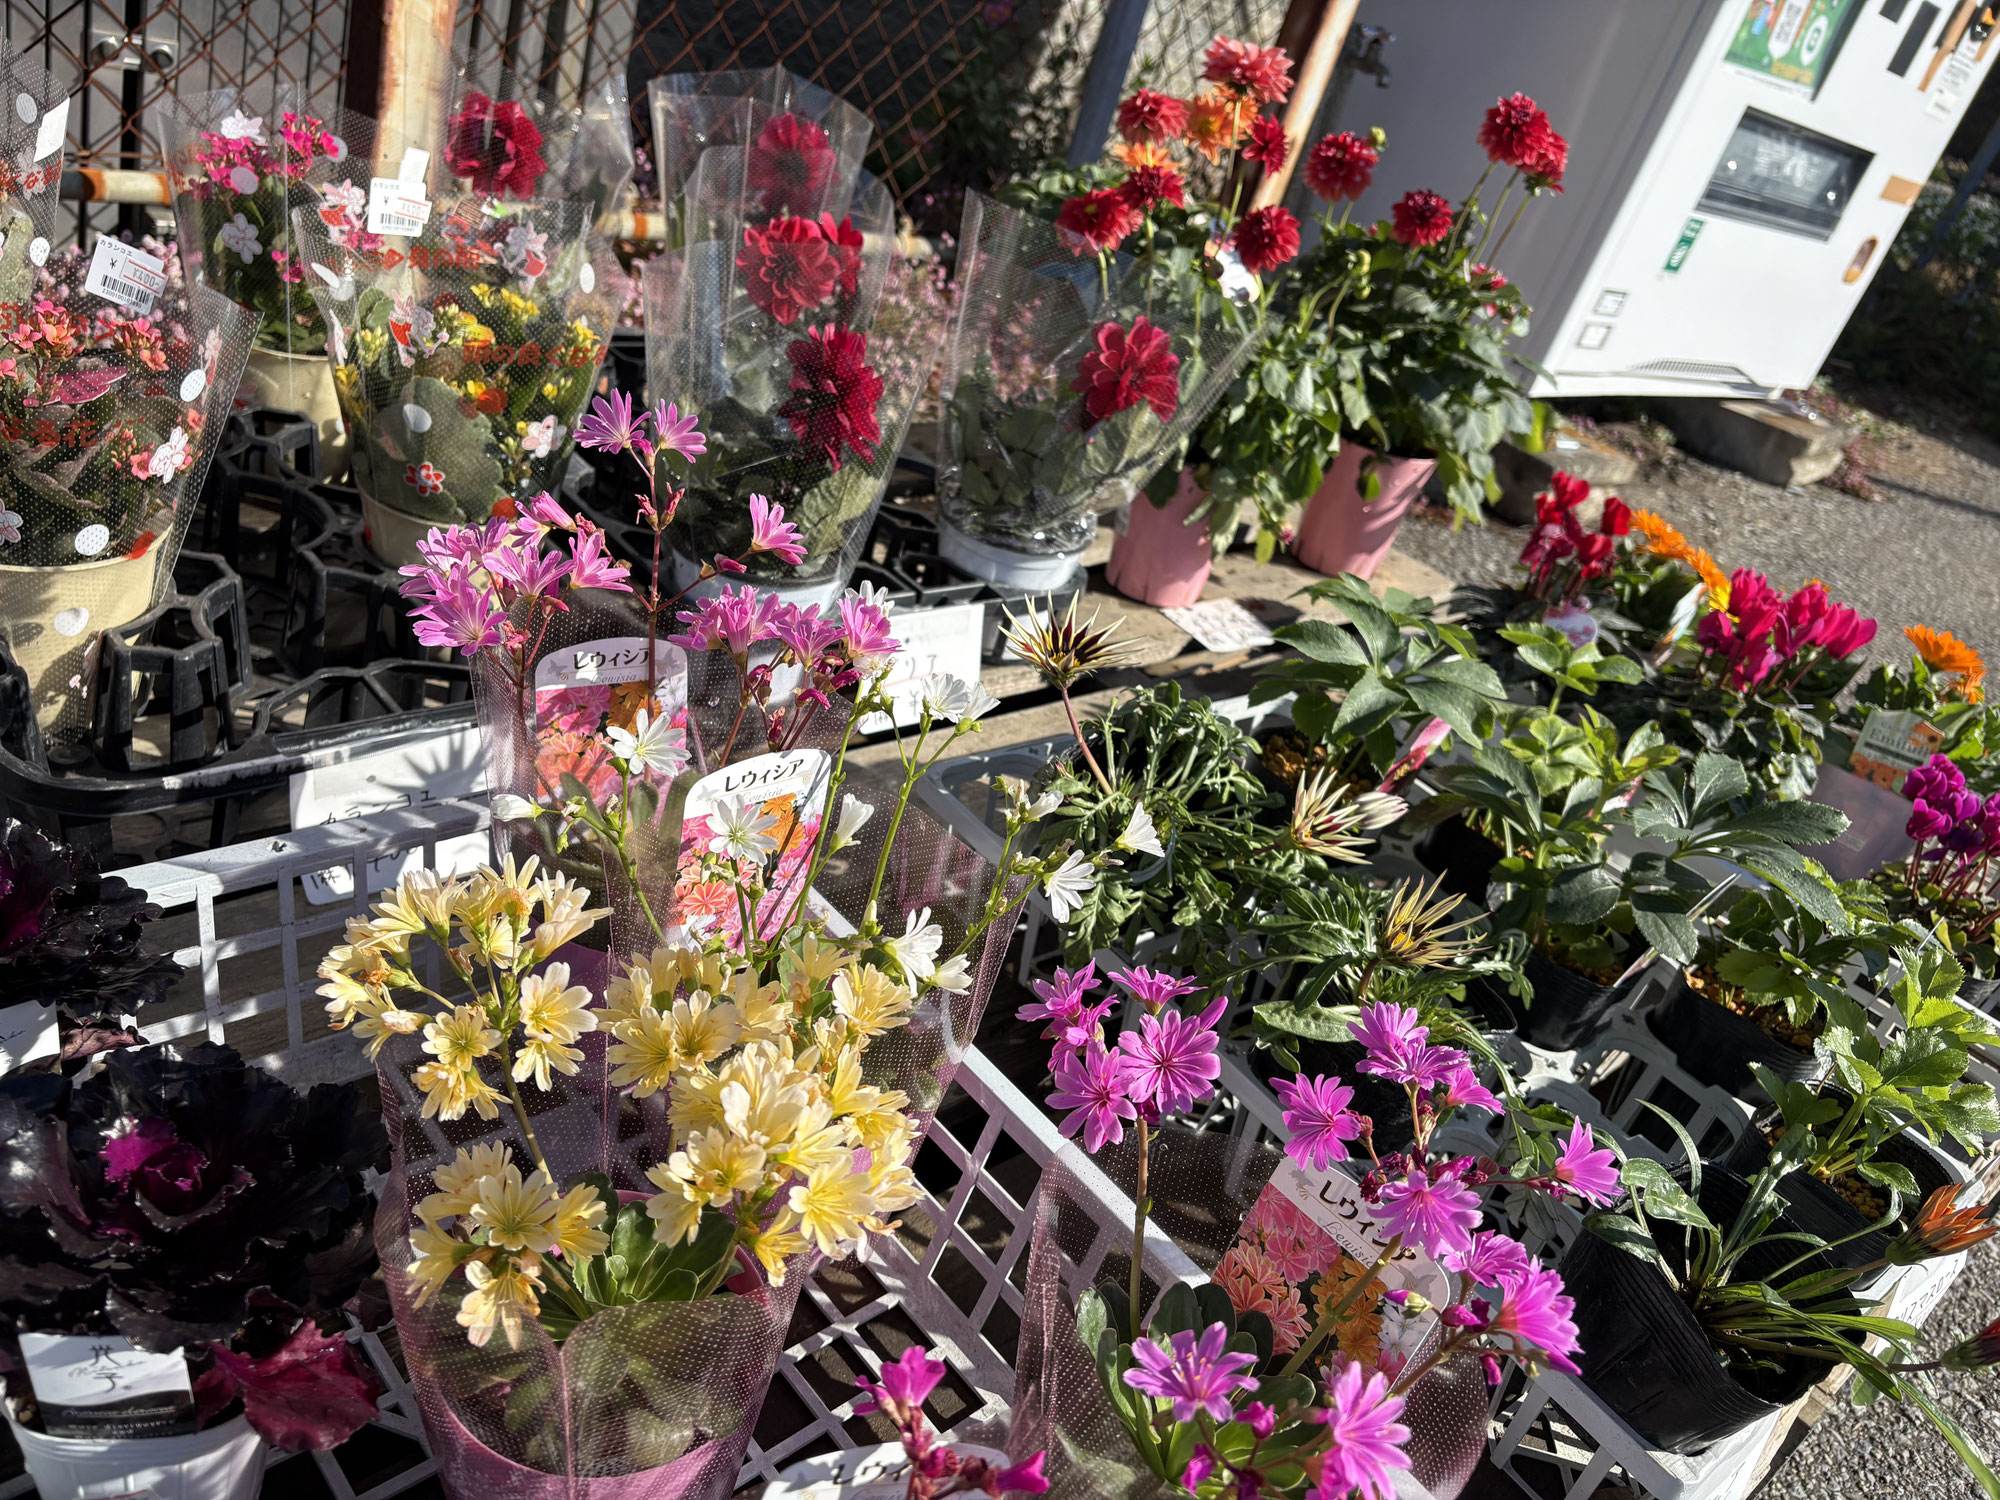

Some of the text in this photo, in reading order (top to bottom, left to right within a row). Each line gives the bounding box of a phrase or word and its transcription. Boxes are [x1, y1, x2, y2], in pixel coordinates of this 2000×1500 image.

[100, 239, 132, 257] カランコエ
[110, 258, 117, 269] ¥
[725, 758, 805, 792] レウィシア
